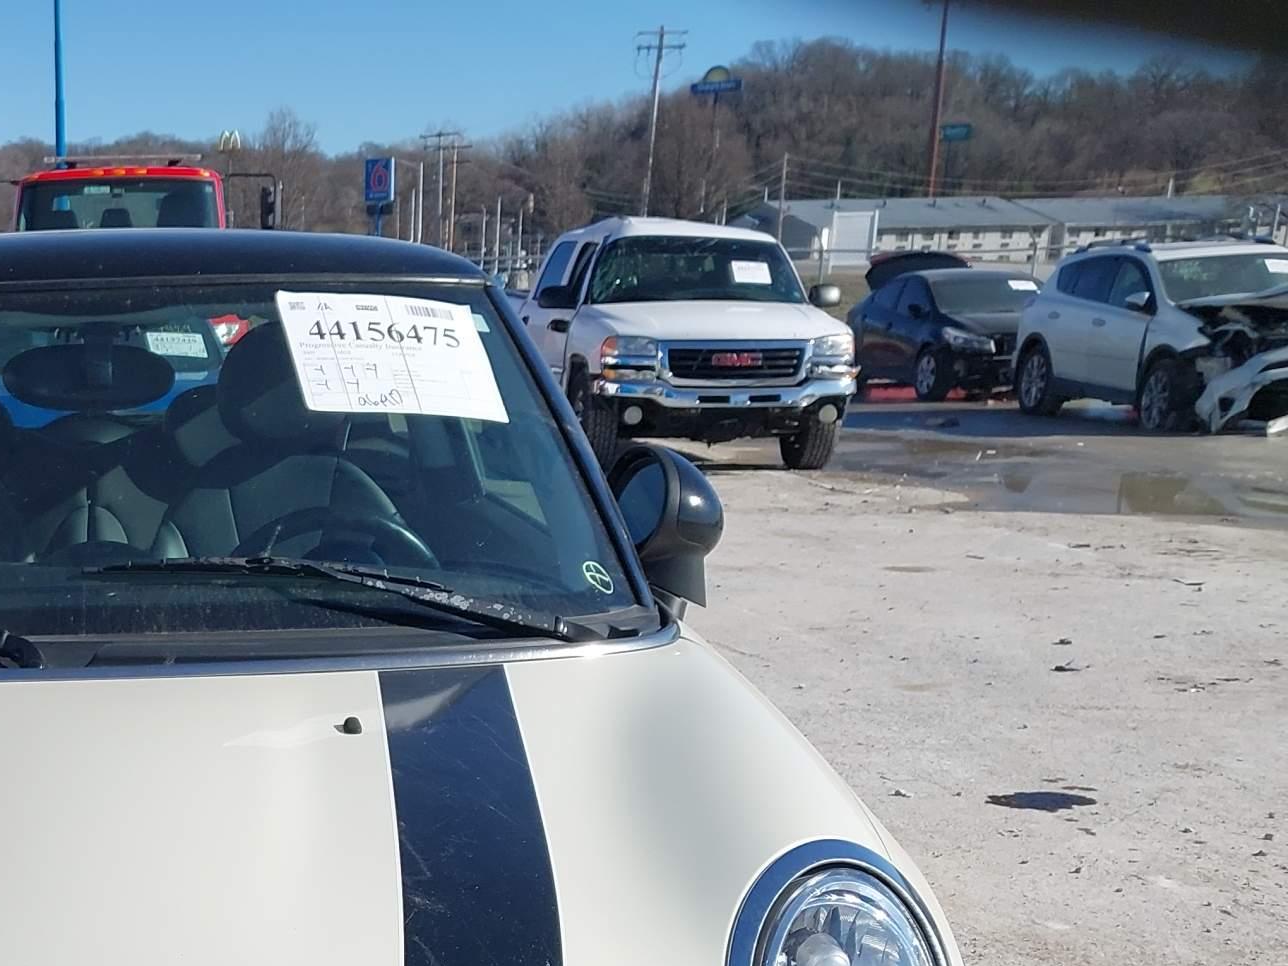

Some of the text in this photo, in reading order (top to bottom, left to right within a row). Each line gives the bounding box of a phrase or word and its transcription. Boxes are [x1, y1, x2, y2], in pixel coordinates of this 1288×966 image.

[370, 160, 389, 192] 6
[308, 319, 461, 349] 44156475
[712, 352, 763, 367] GMC
